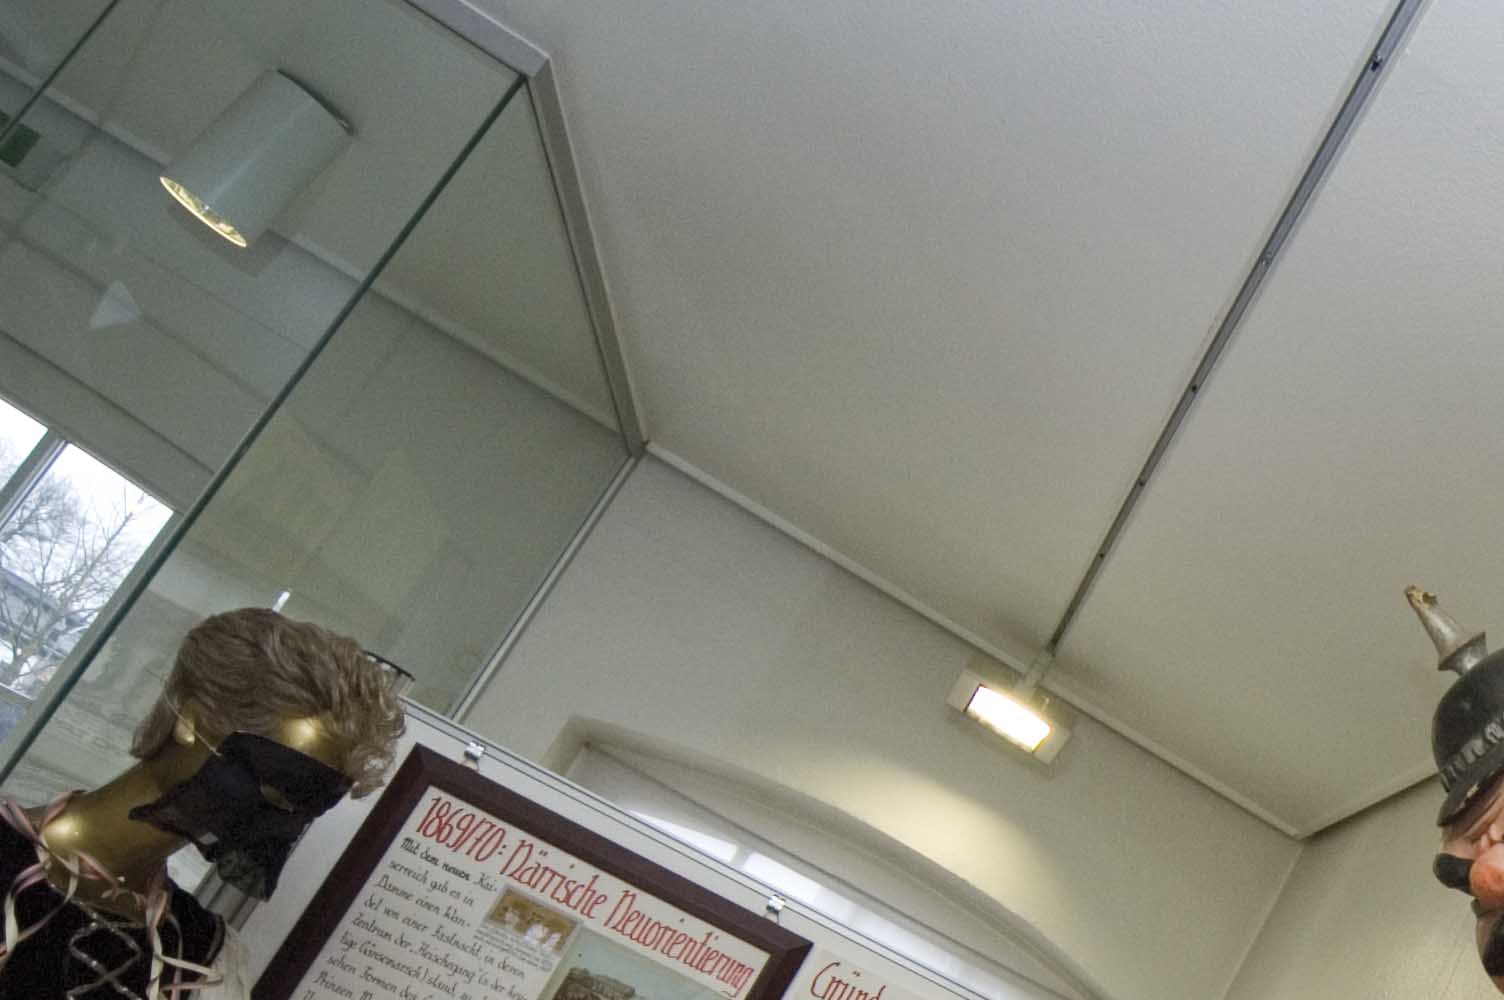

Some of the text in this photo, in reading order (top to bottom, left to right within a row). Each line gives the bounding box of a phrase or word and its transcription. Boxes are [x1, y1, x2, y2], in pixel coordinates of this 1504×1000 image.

[416, 797, 507, 862] 1869/70:
[499, 840, 608, 919] Närrische
[603, 890, 754, 997] Neuorientierung
